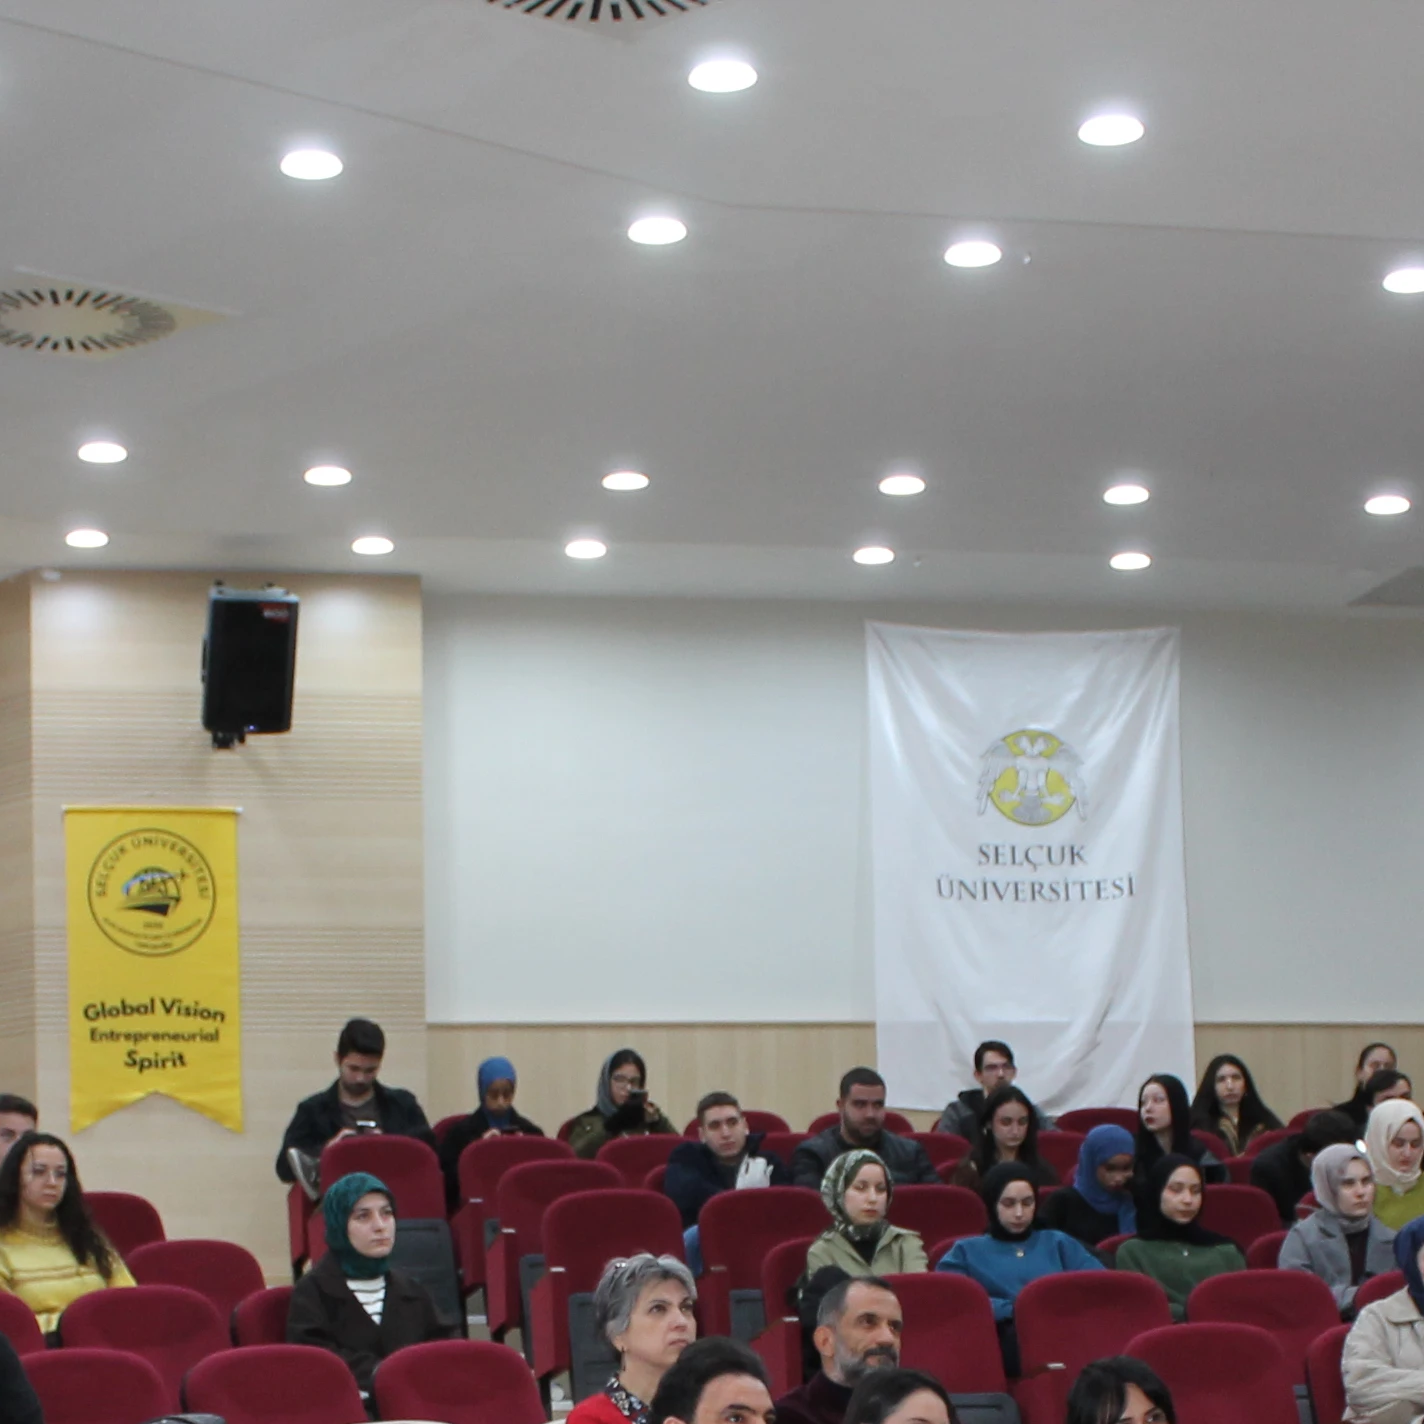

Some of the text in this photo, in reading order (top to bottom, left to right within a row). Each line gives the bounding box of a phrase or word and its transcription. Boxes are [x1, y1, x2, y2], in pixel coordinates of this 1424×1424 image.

[978, 844, 1088, 872] SELÇUK
[936, 872, 1135, 901] ÜNİVERSİTESİ
[83, 998, 225, 1022] Global Vision
[90, 1027, 219, 1045] Entrepreneurial
[124, 1049, 186, 1073] Spirit
